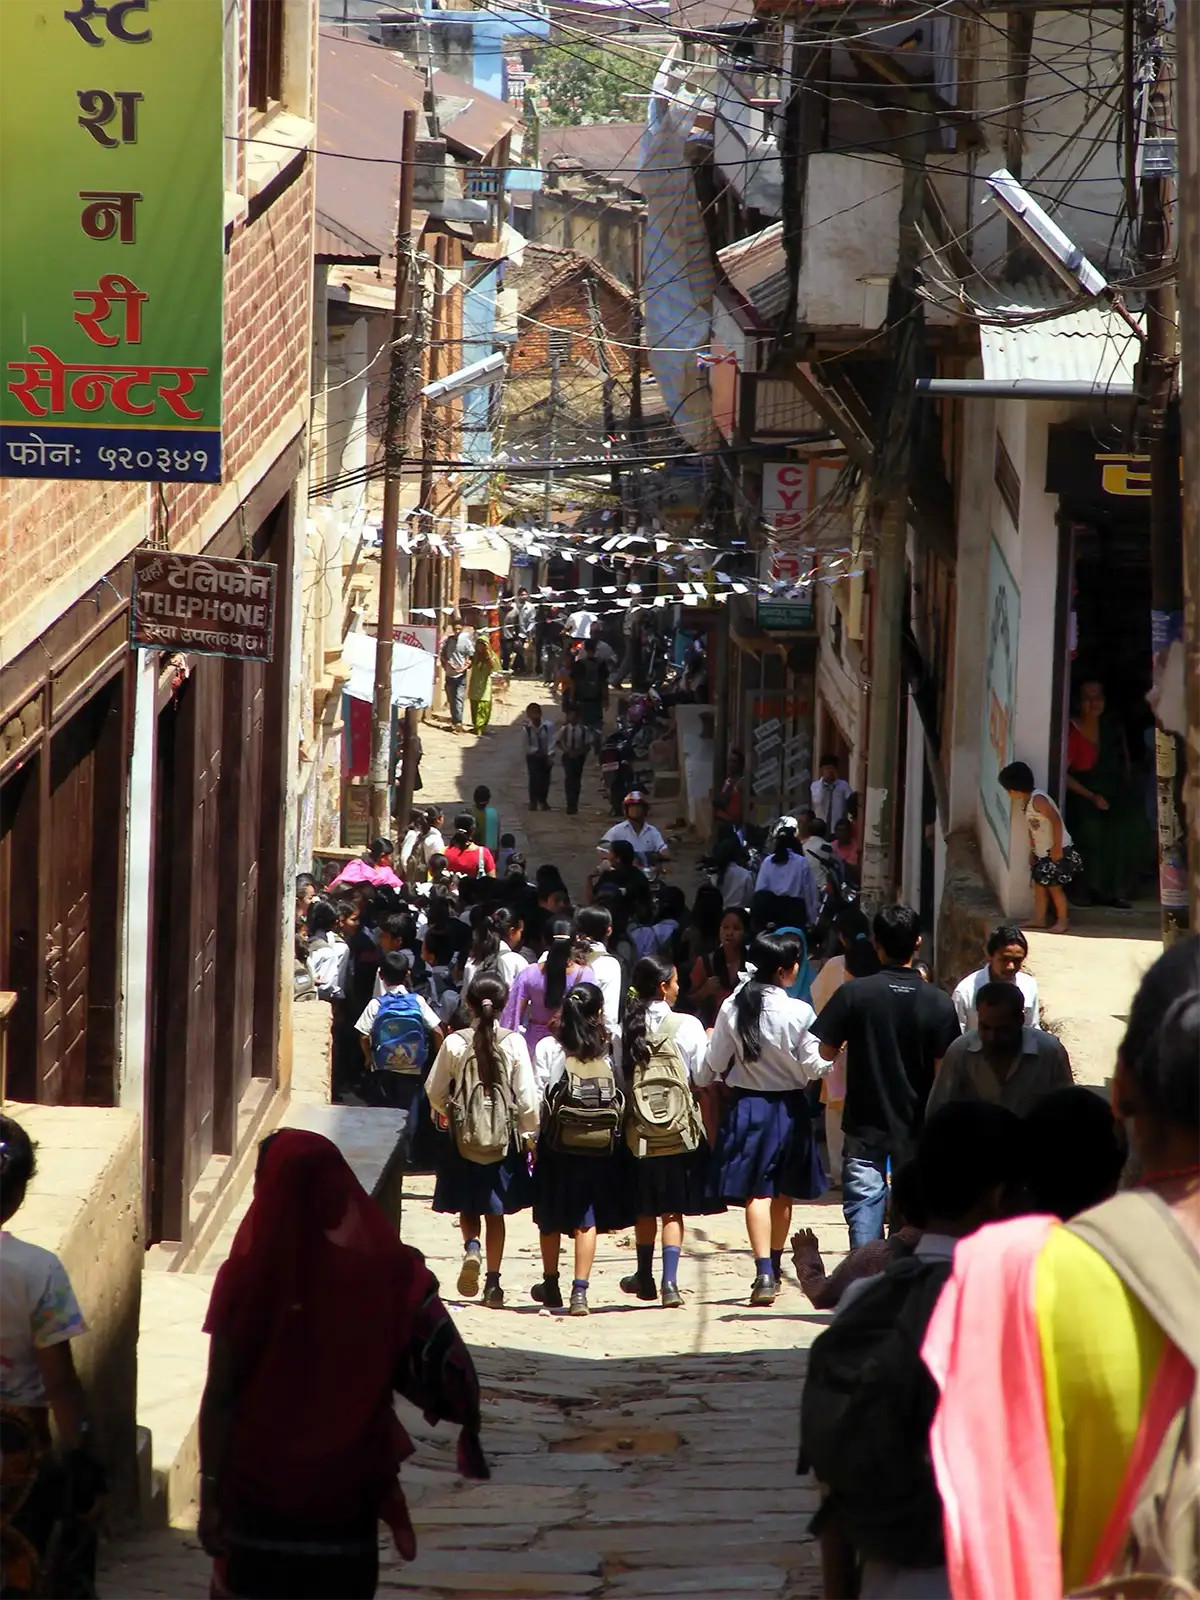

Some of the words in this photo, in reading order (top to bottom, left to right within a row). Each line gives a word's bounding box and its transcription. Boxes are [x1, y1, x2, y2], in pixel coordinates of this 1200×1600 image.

[7, 345, 209, 420] सेन्टर
[98, 446, 208, 473] ५२०३४१
[167, 557, 270, 598] टेलिफोन
[141, 591, 265, 628] TELEPHONE
